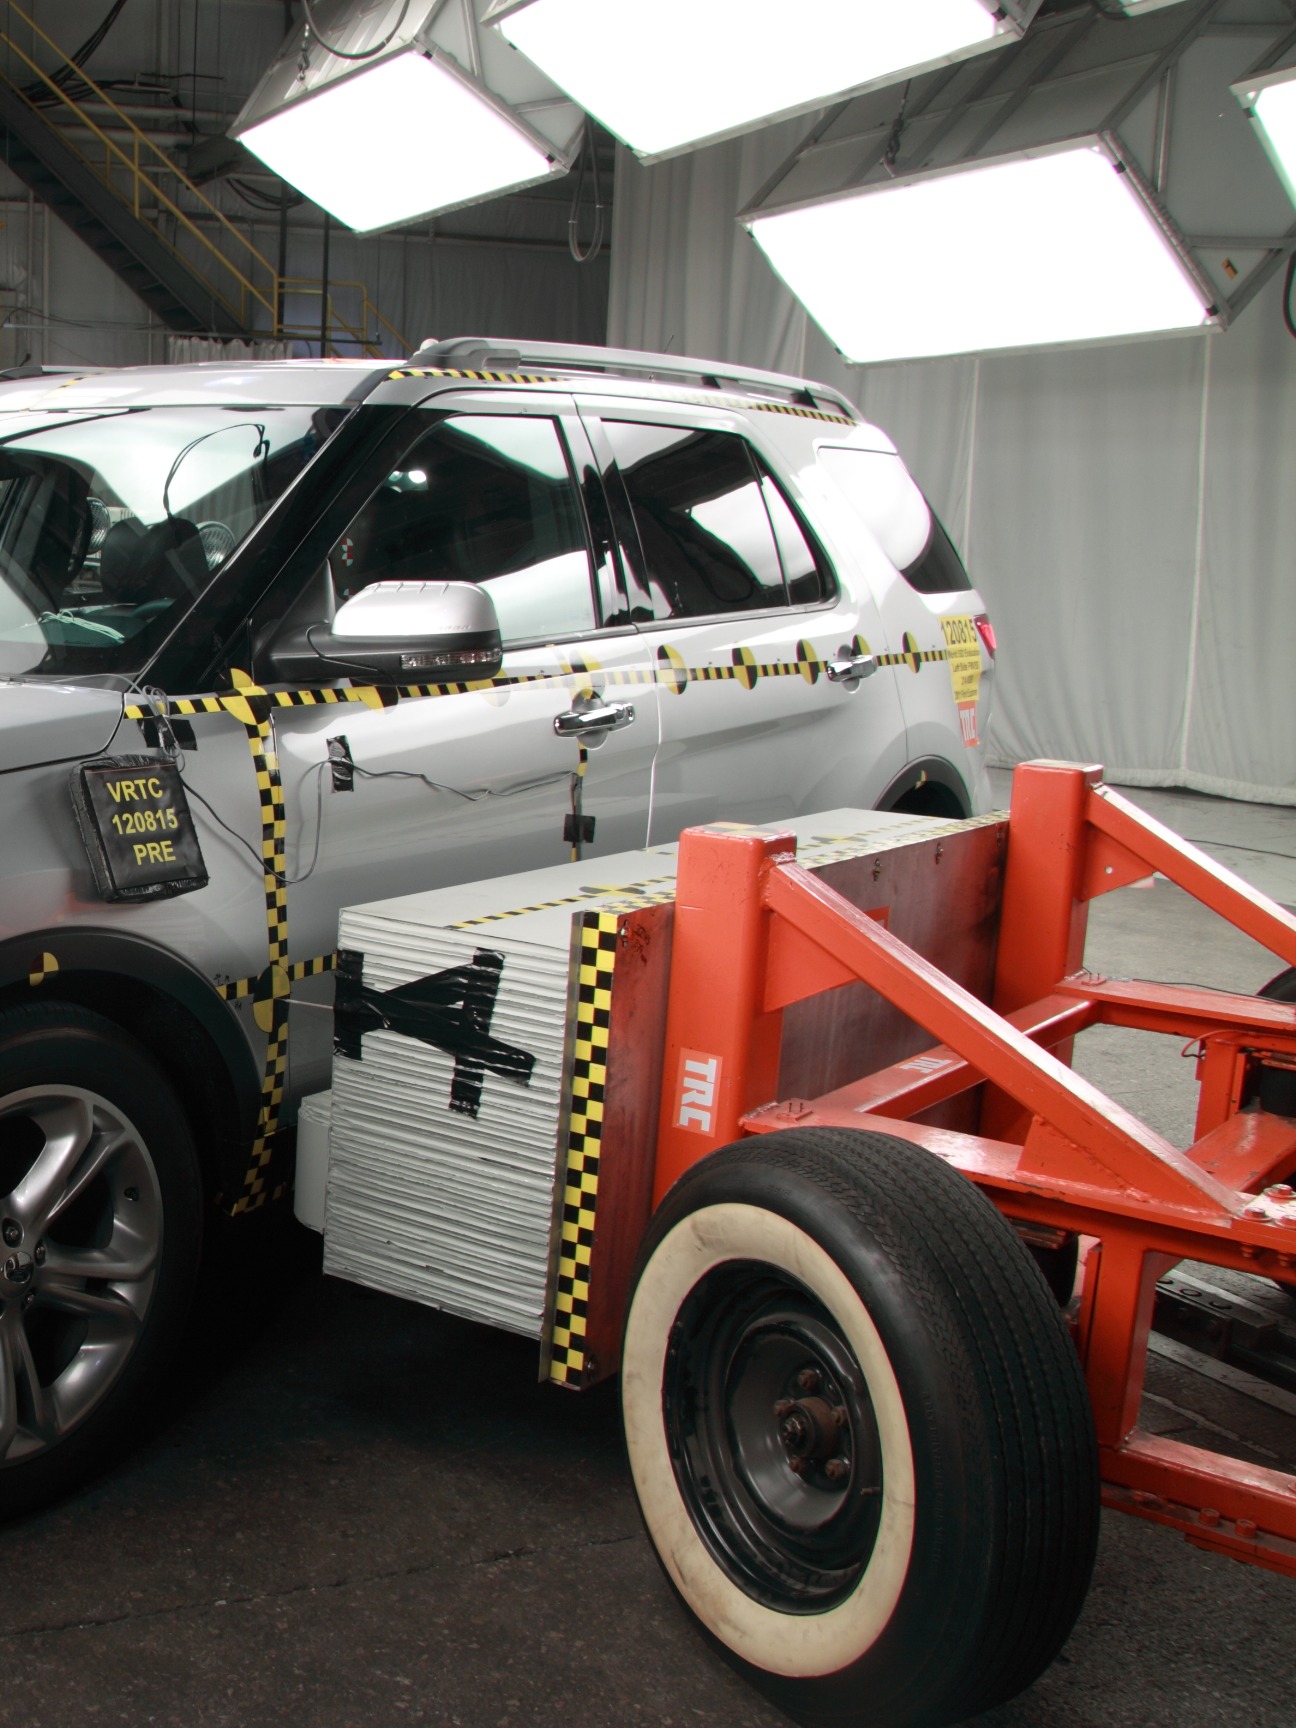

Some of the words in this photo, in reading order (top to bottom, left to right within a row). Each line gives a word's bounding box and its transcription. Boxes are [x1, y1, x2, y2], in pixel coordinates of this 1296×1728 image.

[941, 619, 977, 645] 120815
[106, 777, 163, 802] VRTC
[112, 808, 178, 835] 120815
[133, 840, 176, 865] PRE
[679, 1058, 717, 1132] TRC
